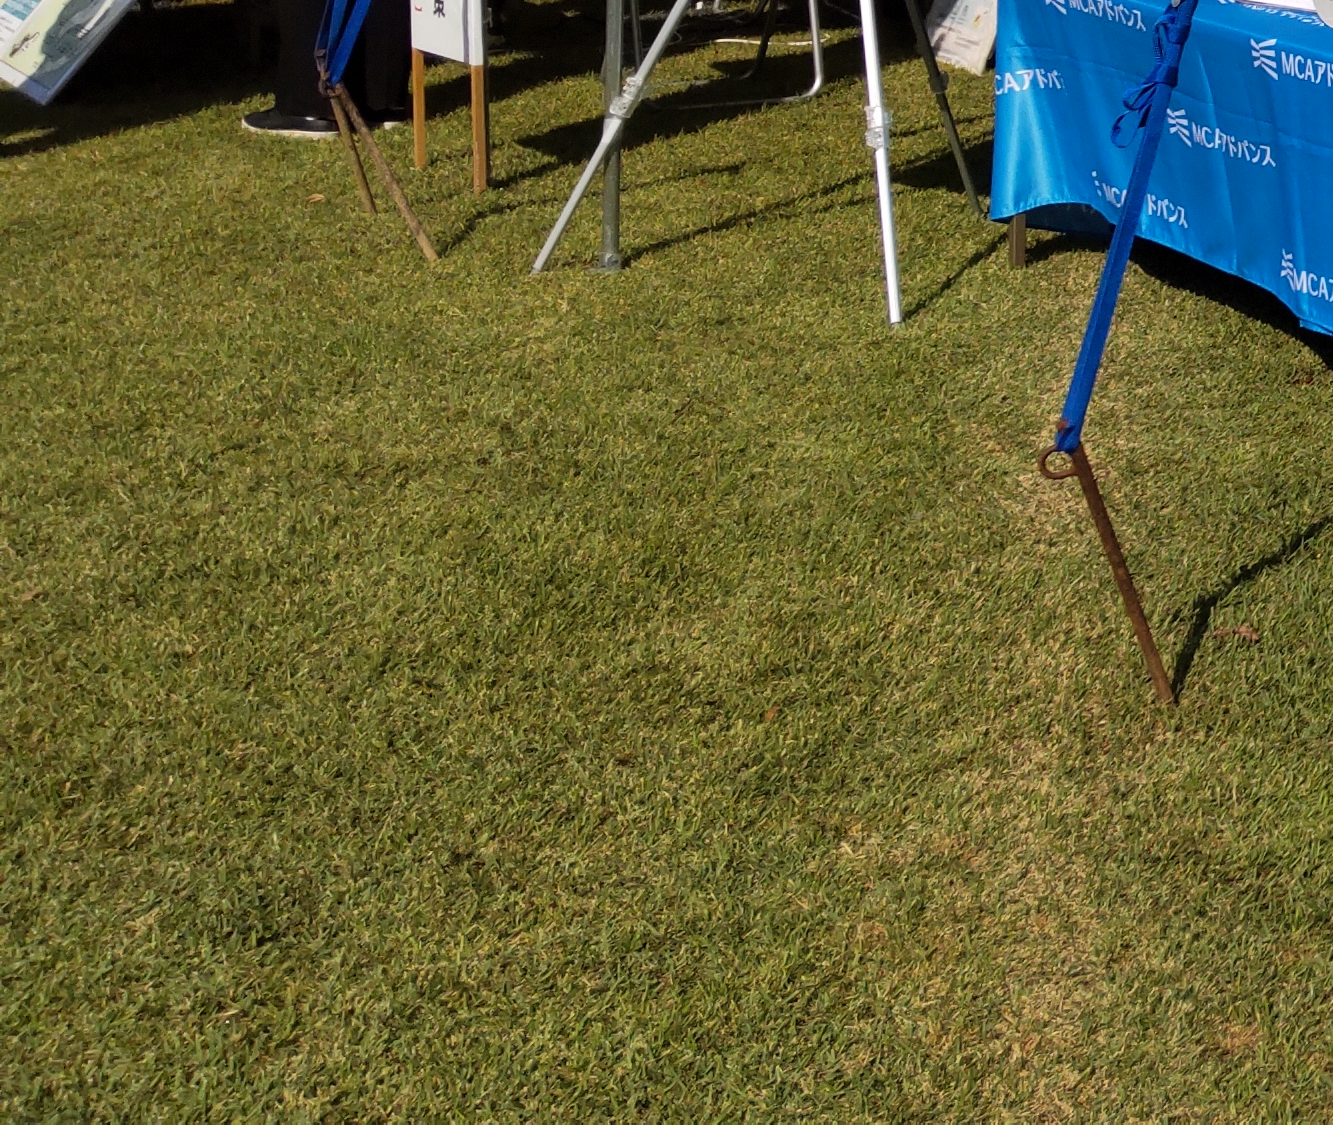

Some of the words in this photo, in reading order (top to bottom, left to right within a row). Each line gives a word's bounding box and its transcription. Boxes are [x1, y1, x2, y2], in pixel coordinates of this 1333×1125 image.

[1192, 121, 1277, 167] MCAアドバンス
